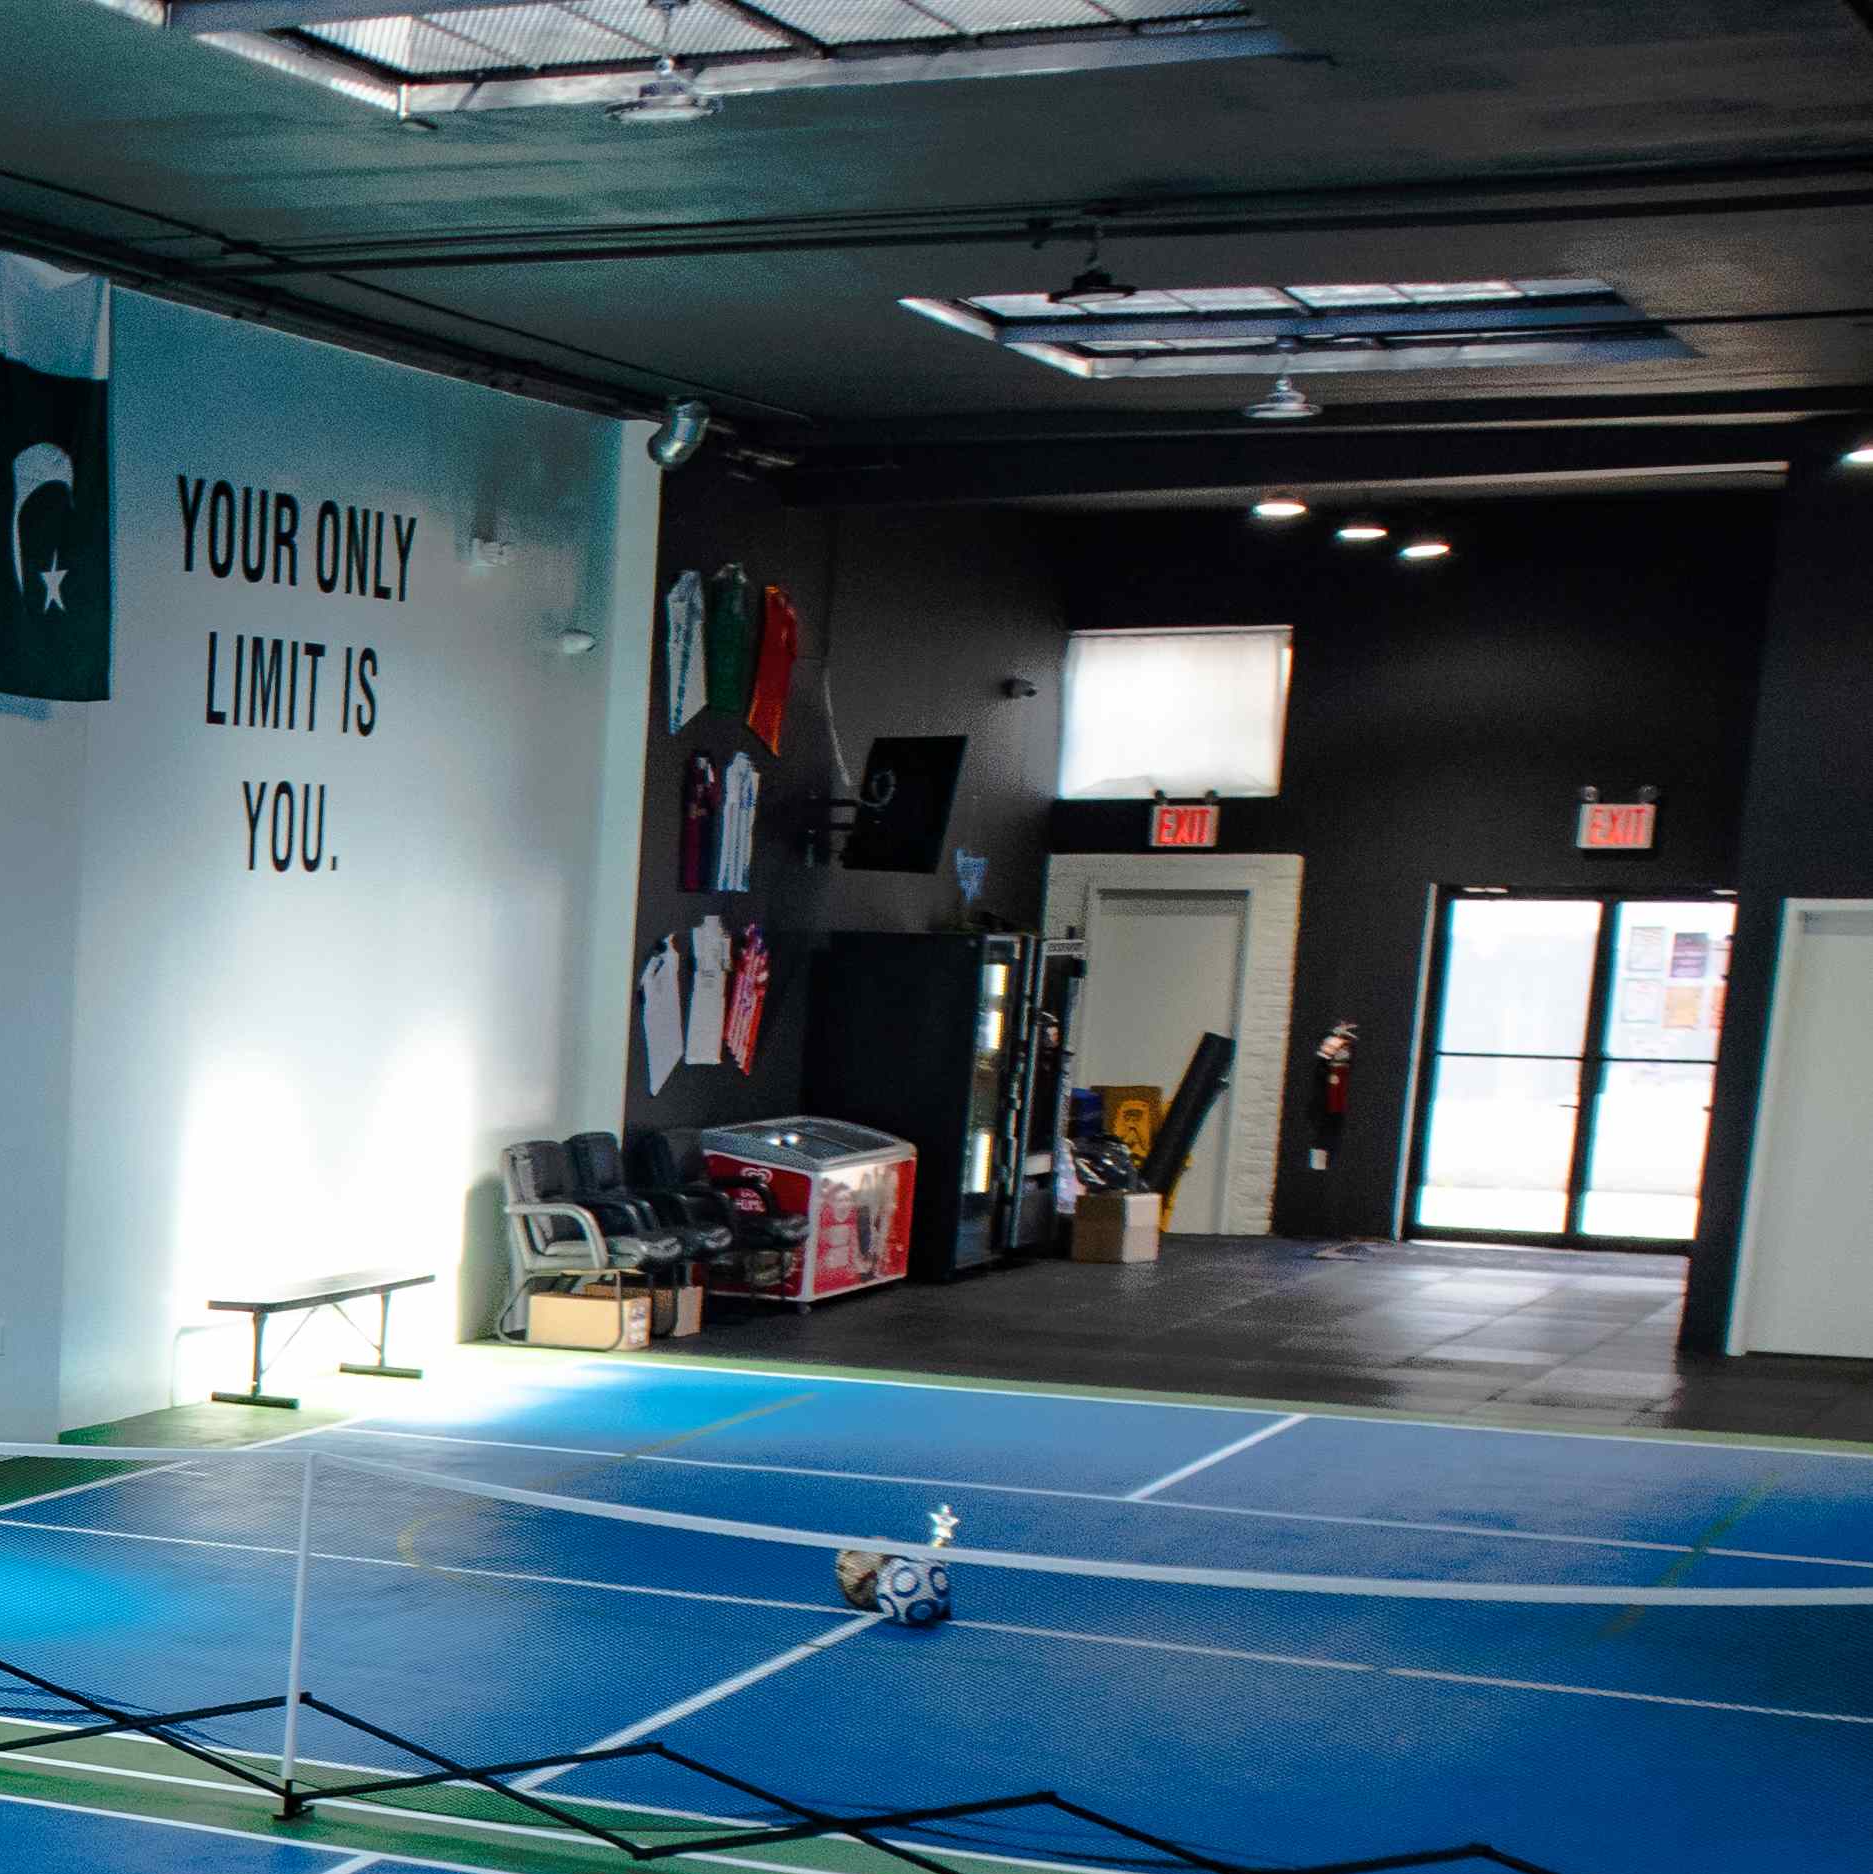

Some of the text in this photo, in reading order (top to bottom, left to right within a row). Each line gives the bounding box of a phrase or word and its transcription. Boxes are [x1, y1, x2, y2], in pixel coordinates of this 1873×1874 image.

[176, 474, 418, 602] YOUR ONLY
[204, 631, 379, 737] LIMIT IS
[242, 780, 339, 873] YOU.
[1157, 808, 1210, 844] EXIT
[1589, 806, 1646, 846] EXIT
